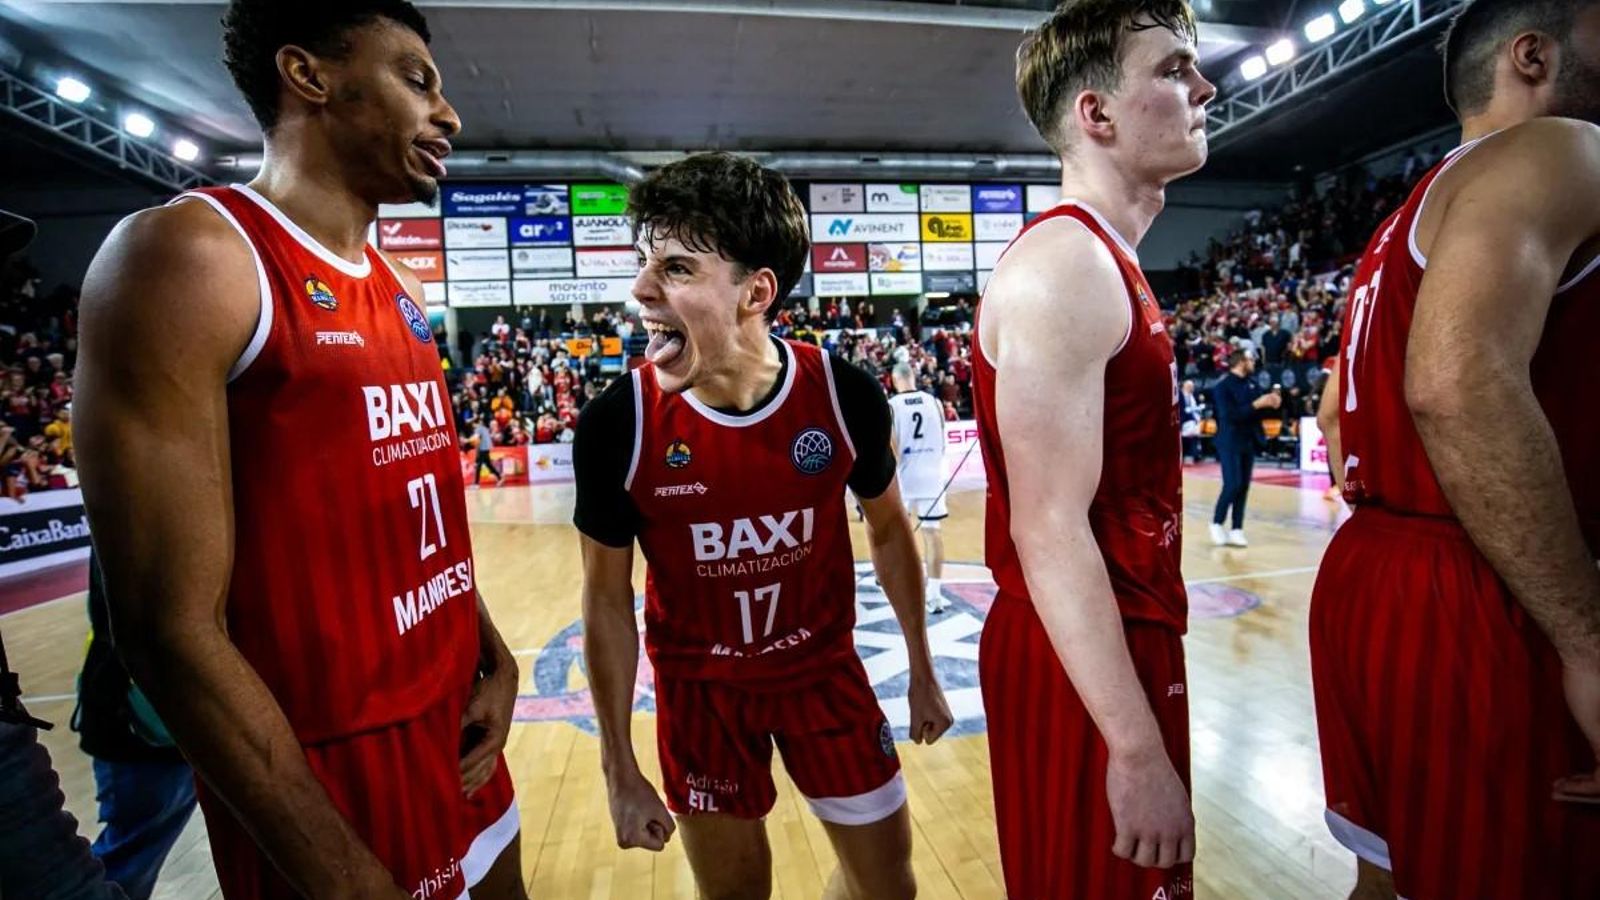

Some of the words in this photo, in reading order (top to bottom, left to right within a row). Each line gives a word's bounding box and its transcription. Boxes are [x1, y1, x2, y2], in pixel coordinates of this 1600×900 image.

[853, 223, 905, 234] AVINENT
[361, 380, 447, 442] BAXI
[912, 411, 924, 440] 2
[407, 472, 447, 561] 21
[689, 507, 815, 562] BAXI
[696, 544, 814, 578] CLIMATIZACIÓN
[392, 557, 473, 637] MANRES
[733, 582, 782, 645] 17
[688, 788, 719, 812] ETL
